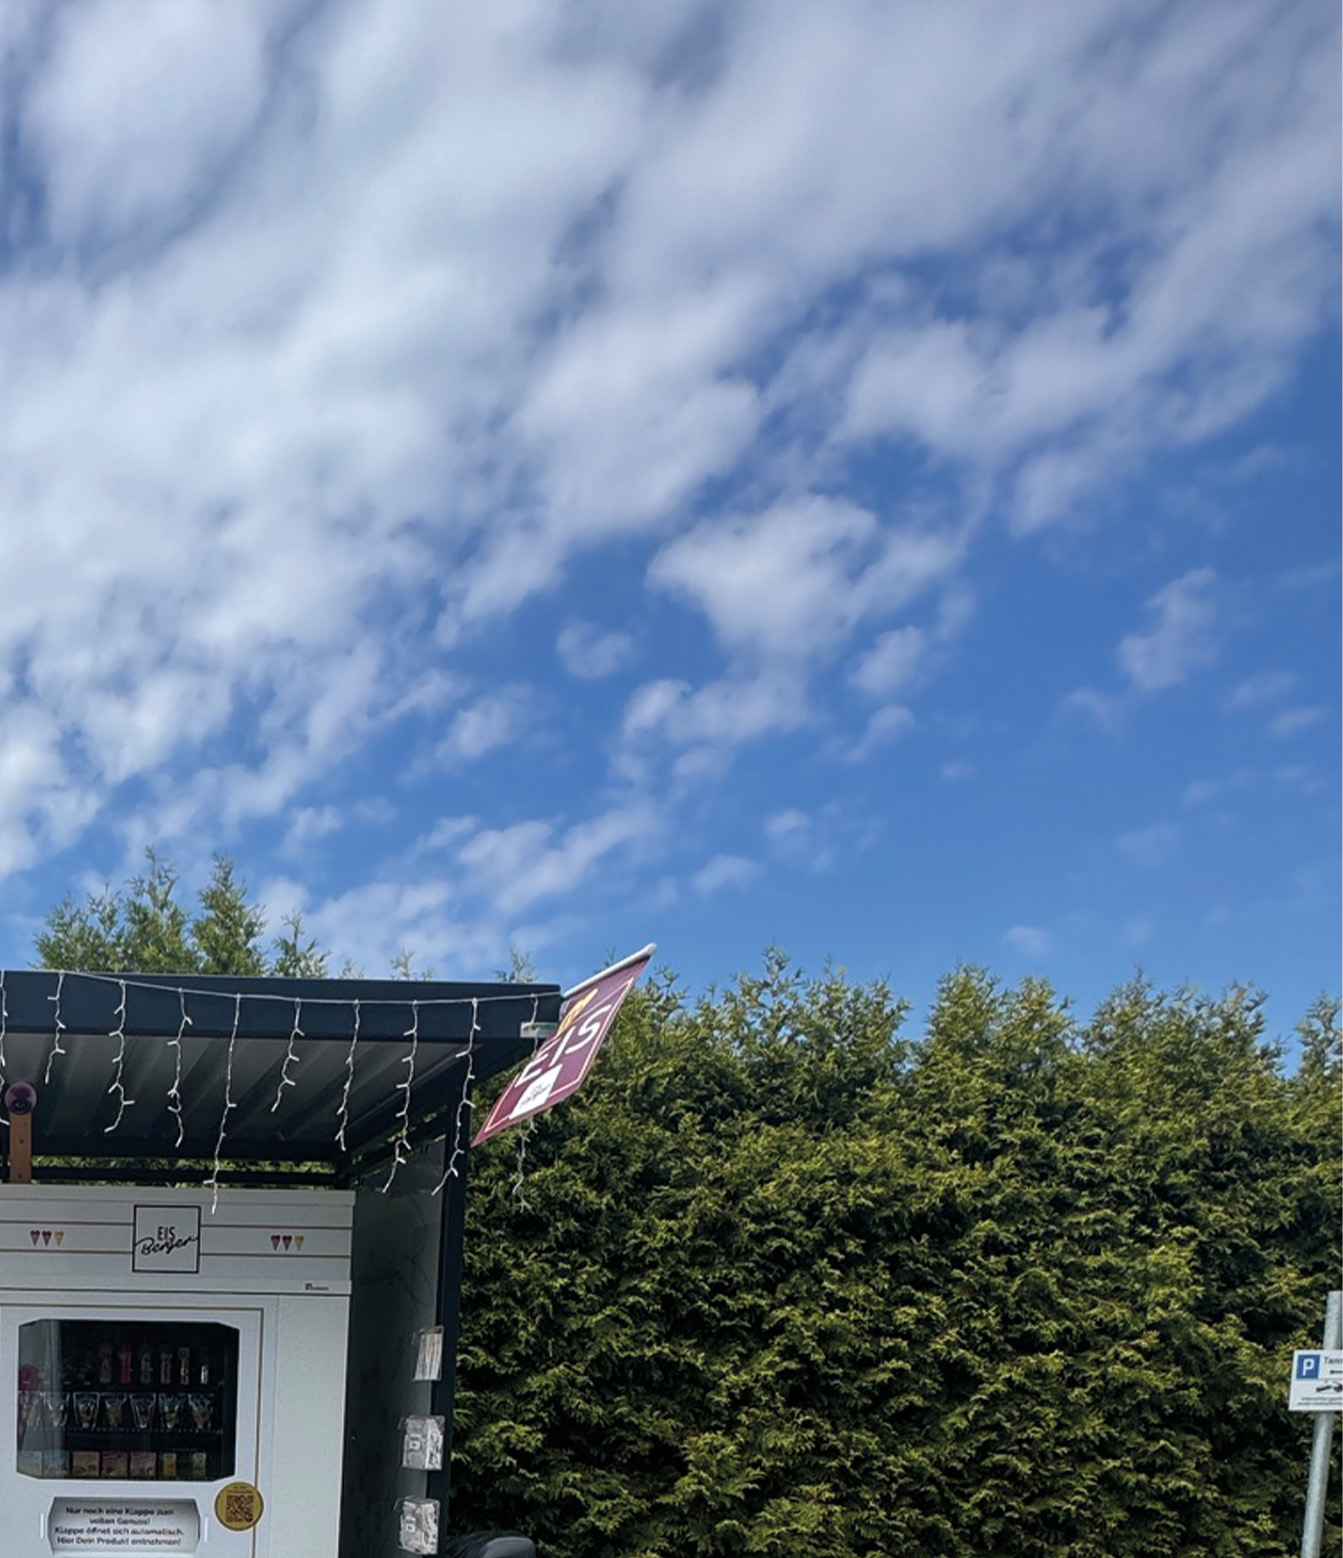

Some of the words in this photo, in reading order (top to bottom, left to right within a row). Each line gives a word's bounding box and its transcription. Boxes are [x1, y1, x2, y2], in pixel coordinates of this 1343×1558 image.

[515, 1004, 612, 1088] EIS
[158, 1226, 176, 1244] EIS
[135, 1236, 199, 1256] Berger
[1302, 1358, 1316, 1377] P
[83, 1506, 105, 1515] noch
[125, 1507, 155, 1517] Klappe
[54, 1526, 85, 1536] Klappe
